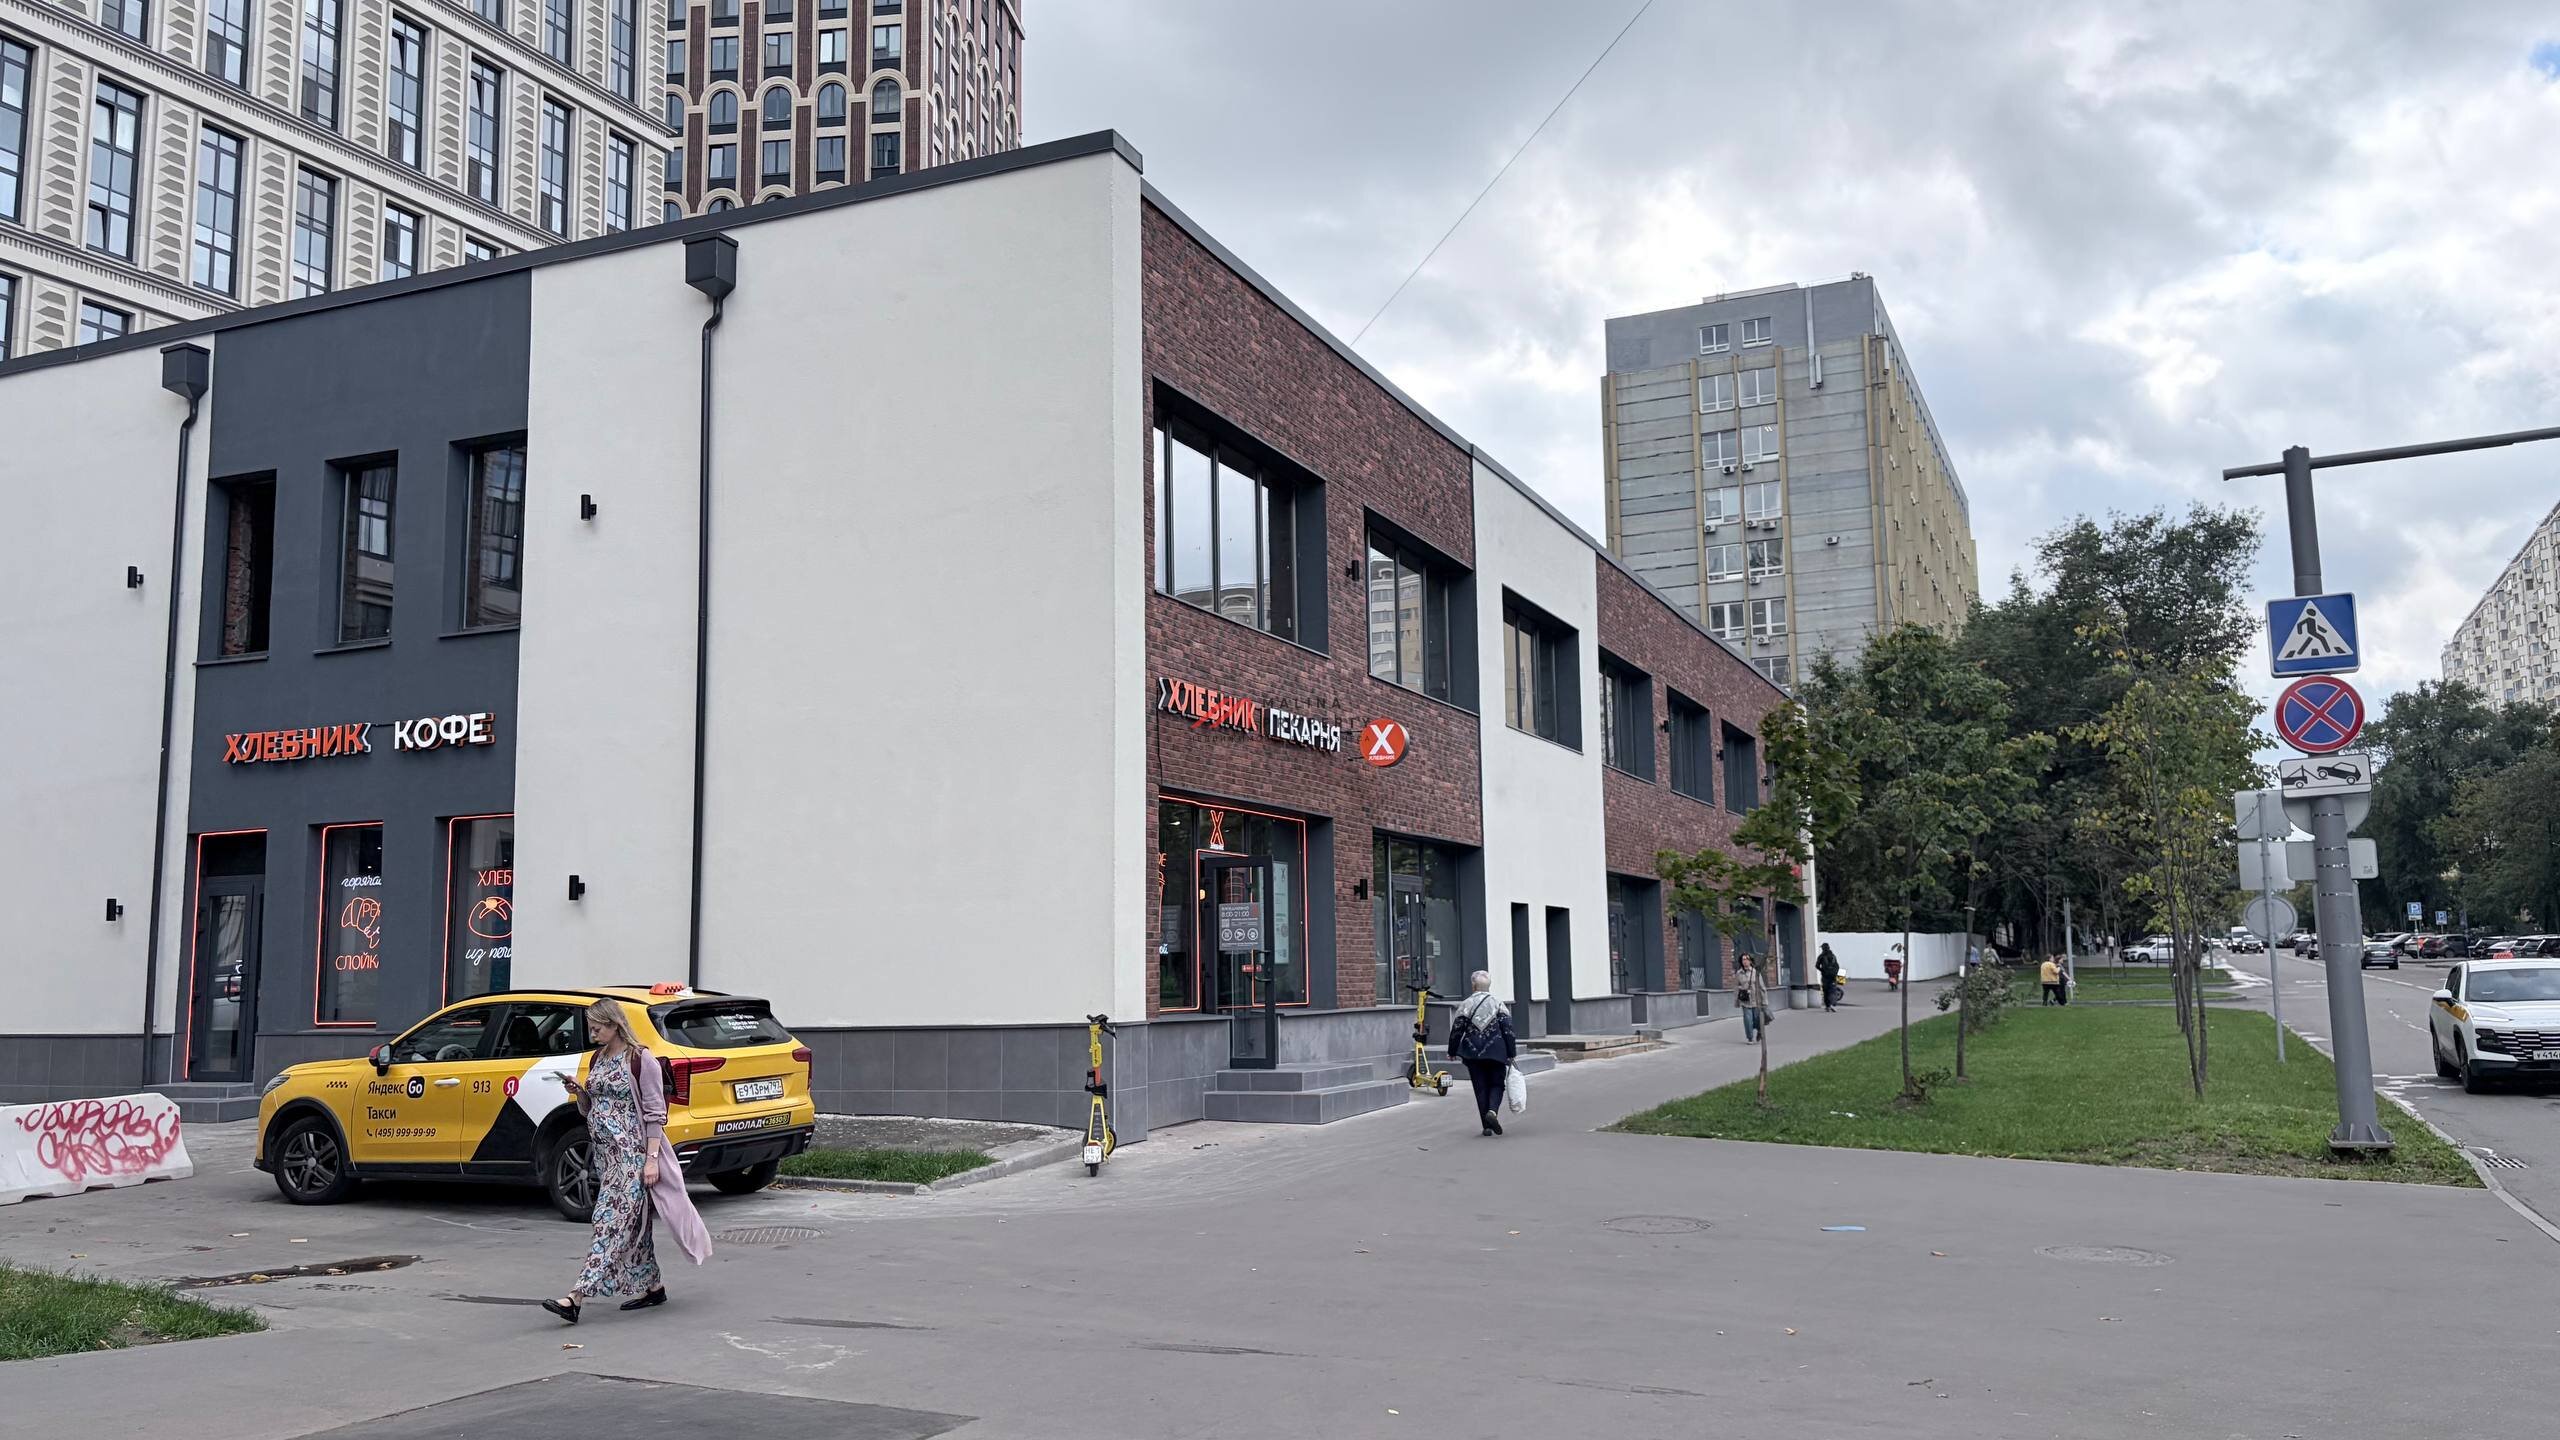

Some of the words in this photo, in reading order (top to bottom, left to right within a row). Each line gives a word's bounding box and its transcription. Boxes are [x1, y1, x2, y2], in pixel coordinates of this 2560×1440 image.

[1167, 677, 1258, 733] ХЛЕБНИК
[1269, 707, 1341, 753] ПЕКАРНЯ
[222, 722, 365, 763] ХЛЕБНИК
[393, 712, 490, 750] КОФЕ
[477, 869, 513, 887] ХЛЕБ
[465, 948, 487, 966] из
[2536, 1051, 2560, 1059] У414
[367, 1080, 405, 1096] Яндекс
[408, 1080, 423, 1095] Go
[473, 1080, 491, 1094] 913
[367, 1106, 397, 1120] Такси
[374, 1128, 395, 1138] (495)
[395, 1127, 437, 1138] 999-99-99
[717, 1119, 763, 1133] ШОКОЛАД
